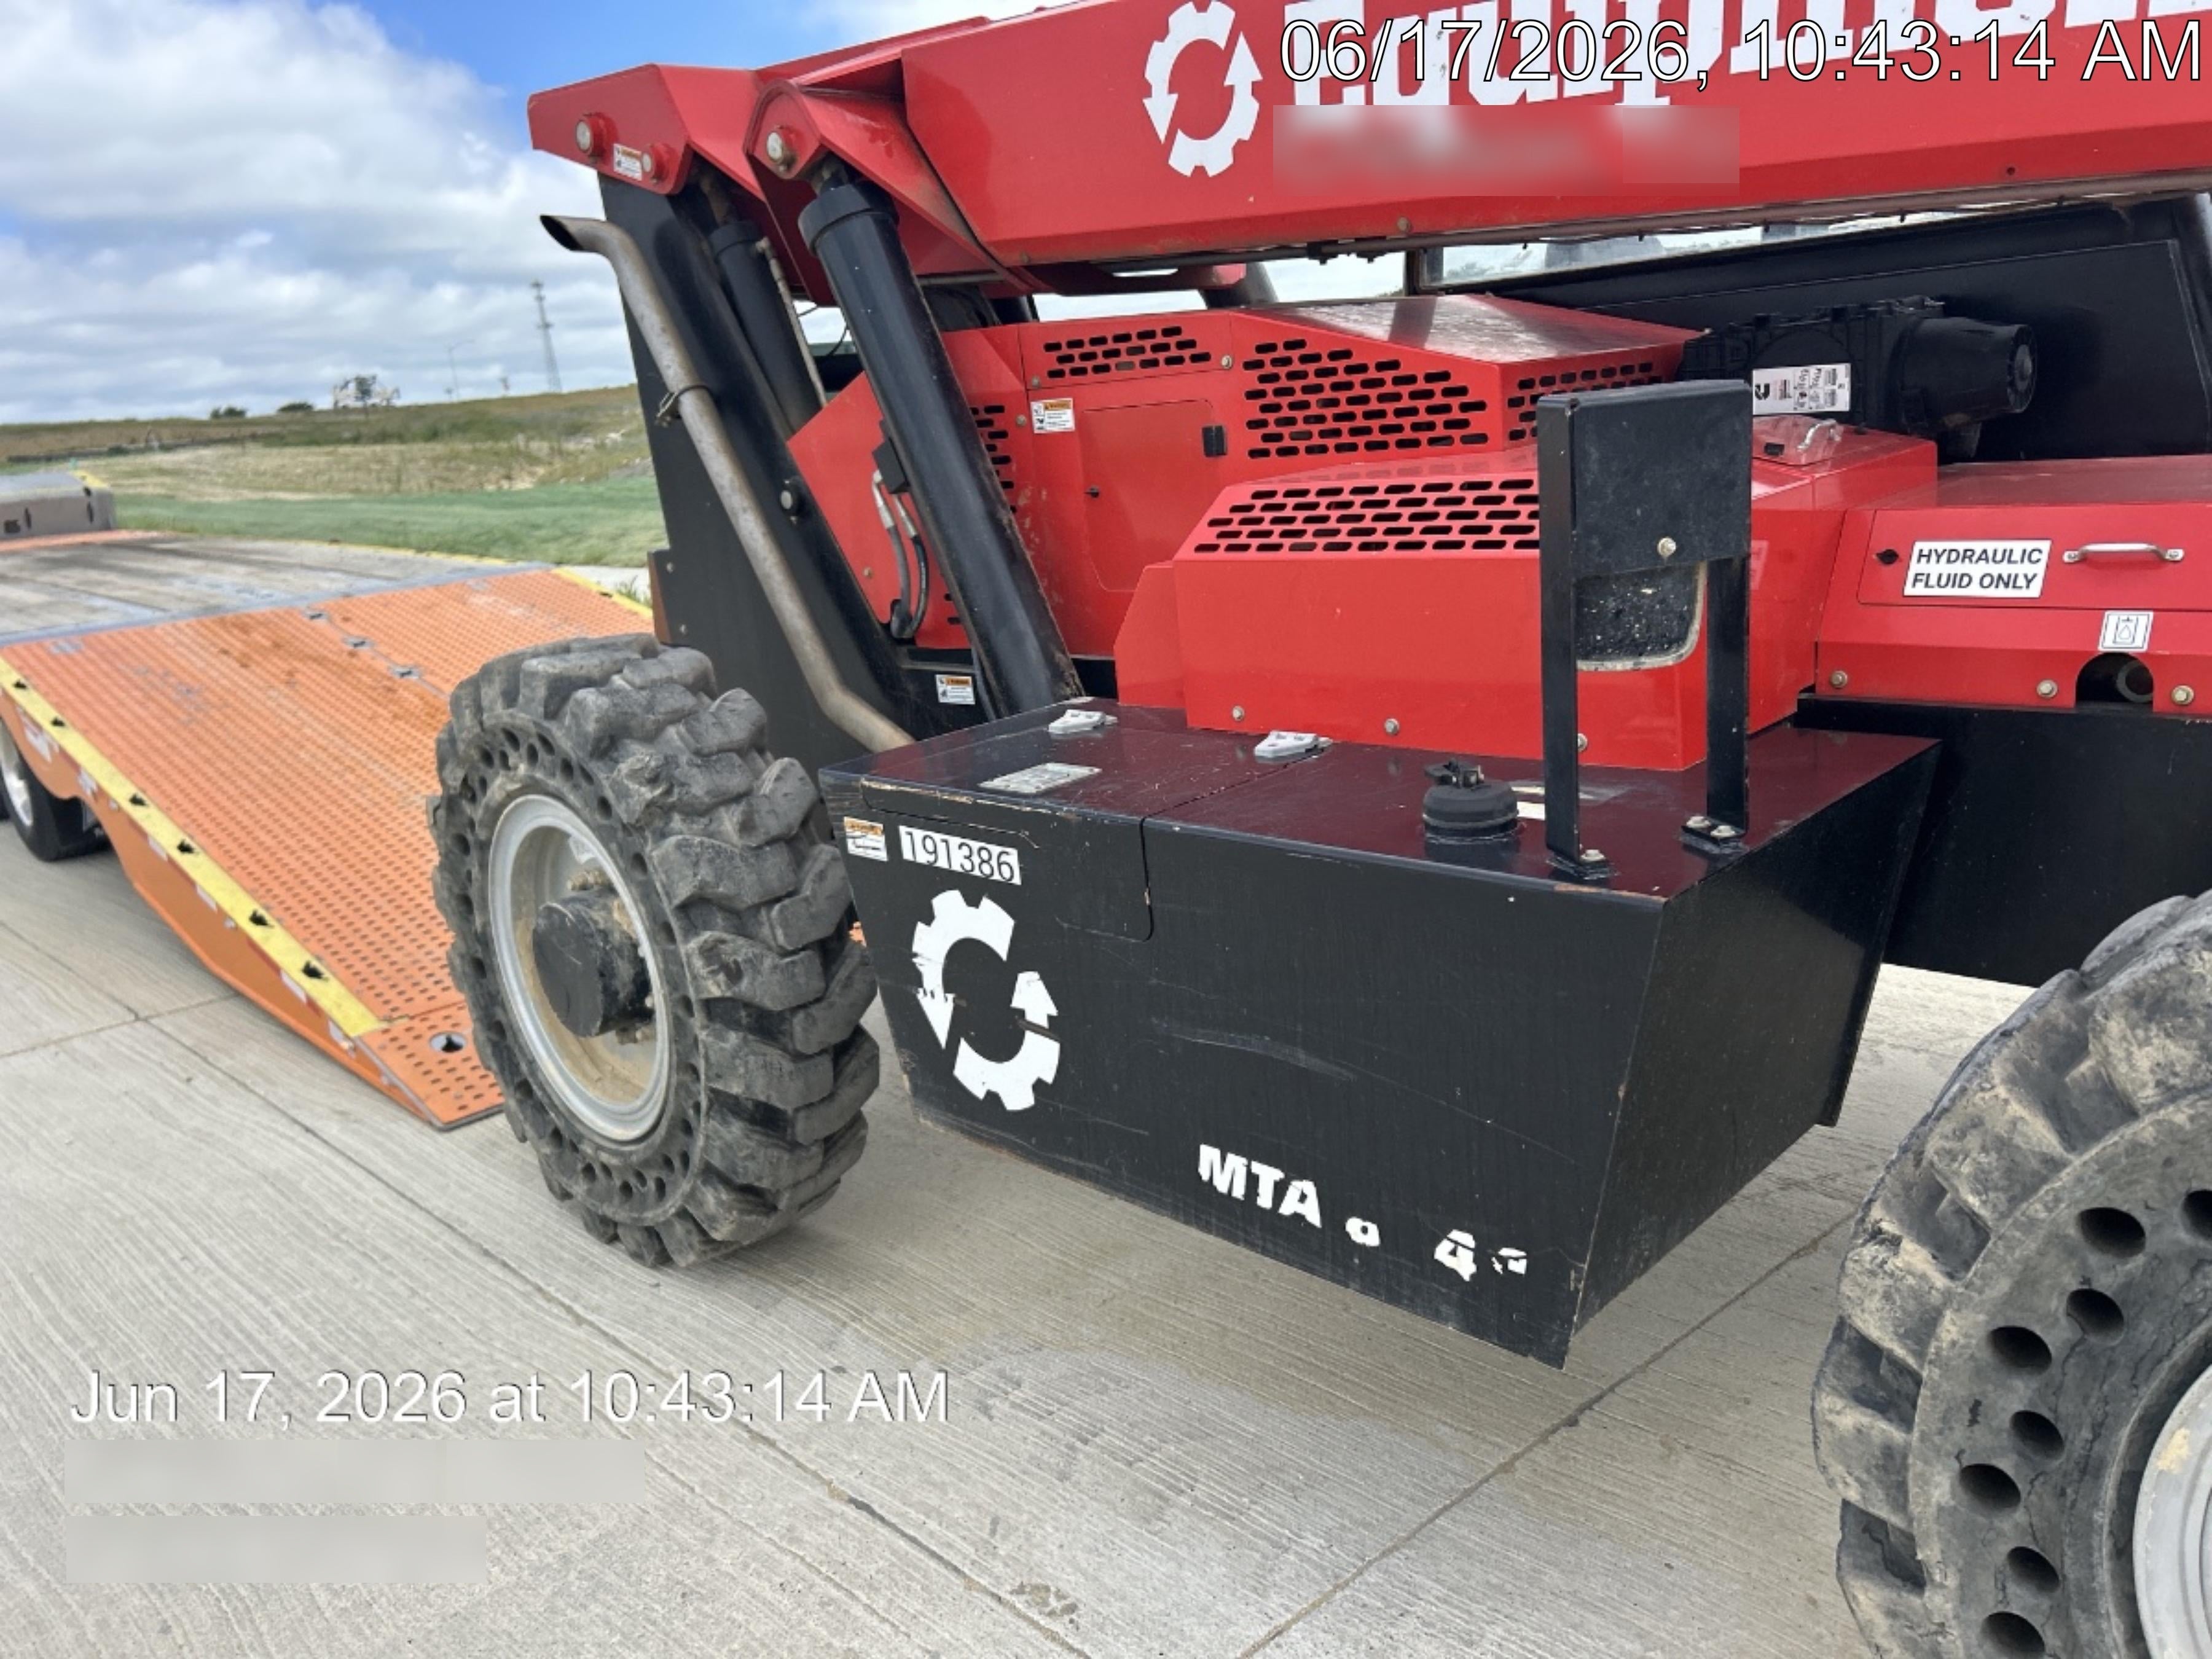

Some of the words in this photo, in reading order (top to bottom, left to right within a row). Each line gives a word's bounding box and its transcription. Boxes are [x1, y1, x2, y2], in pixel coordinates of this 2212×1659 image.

[1916, 548, 2042, 565] HYDRAULIC
[1912, 572, 1973, 589] FLUID
[1979, 572, 2037, 590] ONLY
[905, 831, 1014, 882] 191386
[1198, 1143, 1322, 1228] MTA
